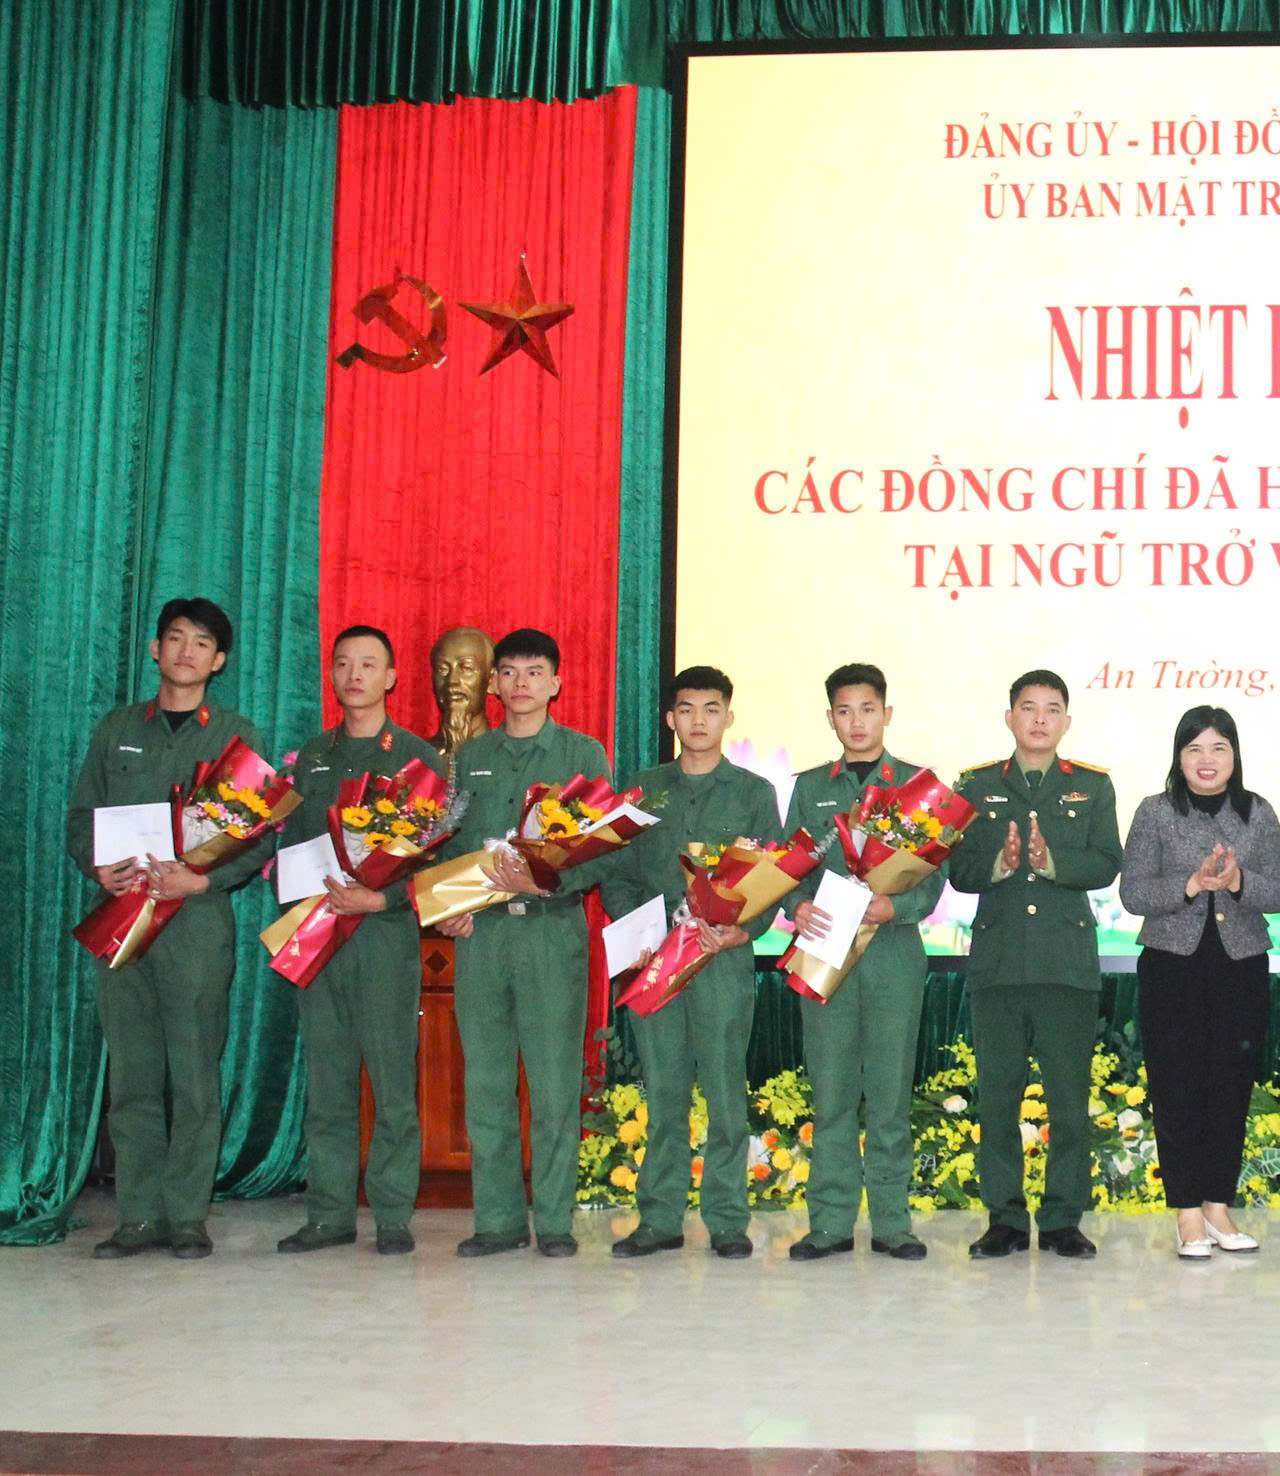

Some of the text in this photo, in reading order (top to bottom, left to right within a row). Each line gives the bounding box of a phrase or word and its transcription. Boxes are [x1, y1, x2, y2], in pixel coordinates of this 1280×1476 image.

[944, 111, 1053, 158] ĐẢNG
[1067, 110, 1118, 157] ỦY
[1151, 114, 1221, 165] HỘI
[983, 172, 1034, 219] ỦY
[1046, 183, 1121, 219] BAN
[1135, 176, 1222, 227] MẶT
[1044, 286, 1248, 430] NHIỆT
[753, 456, 864, 515] CÁC
[879, 454, 1034, 513] ĐỒNG
[1051, 453, 1148, 511] CHÍ
[1164, 455, 1239, 510] ĐÃ
[903, 543, 993, 601] TẠI
[1011, 530, 1125, 588] NGŨ
[1141, 528, 1257, 587] TRỞ
[1086, 660, 1136, 689] An
[1152, 659, 1275, 697] Tường,
